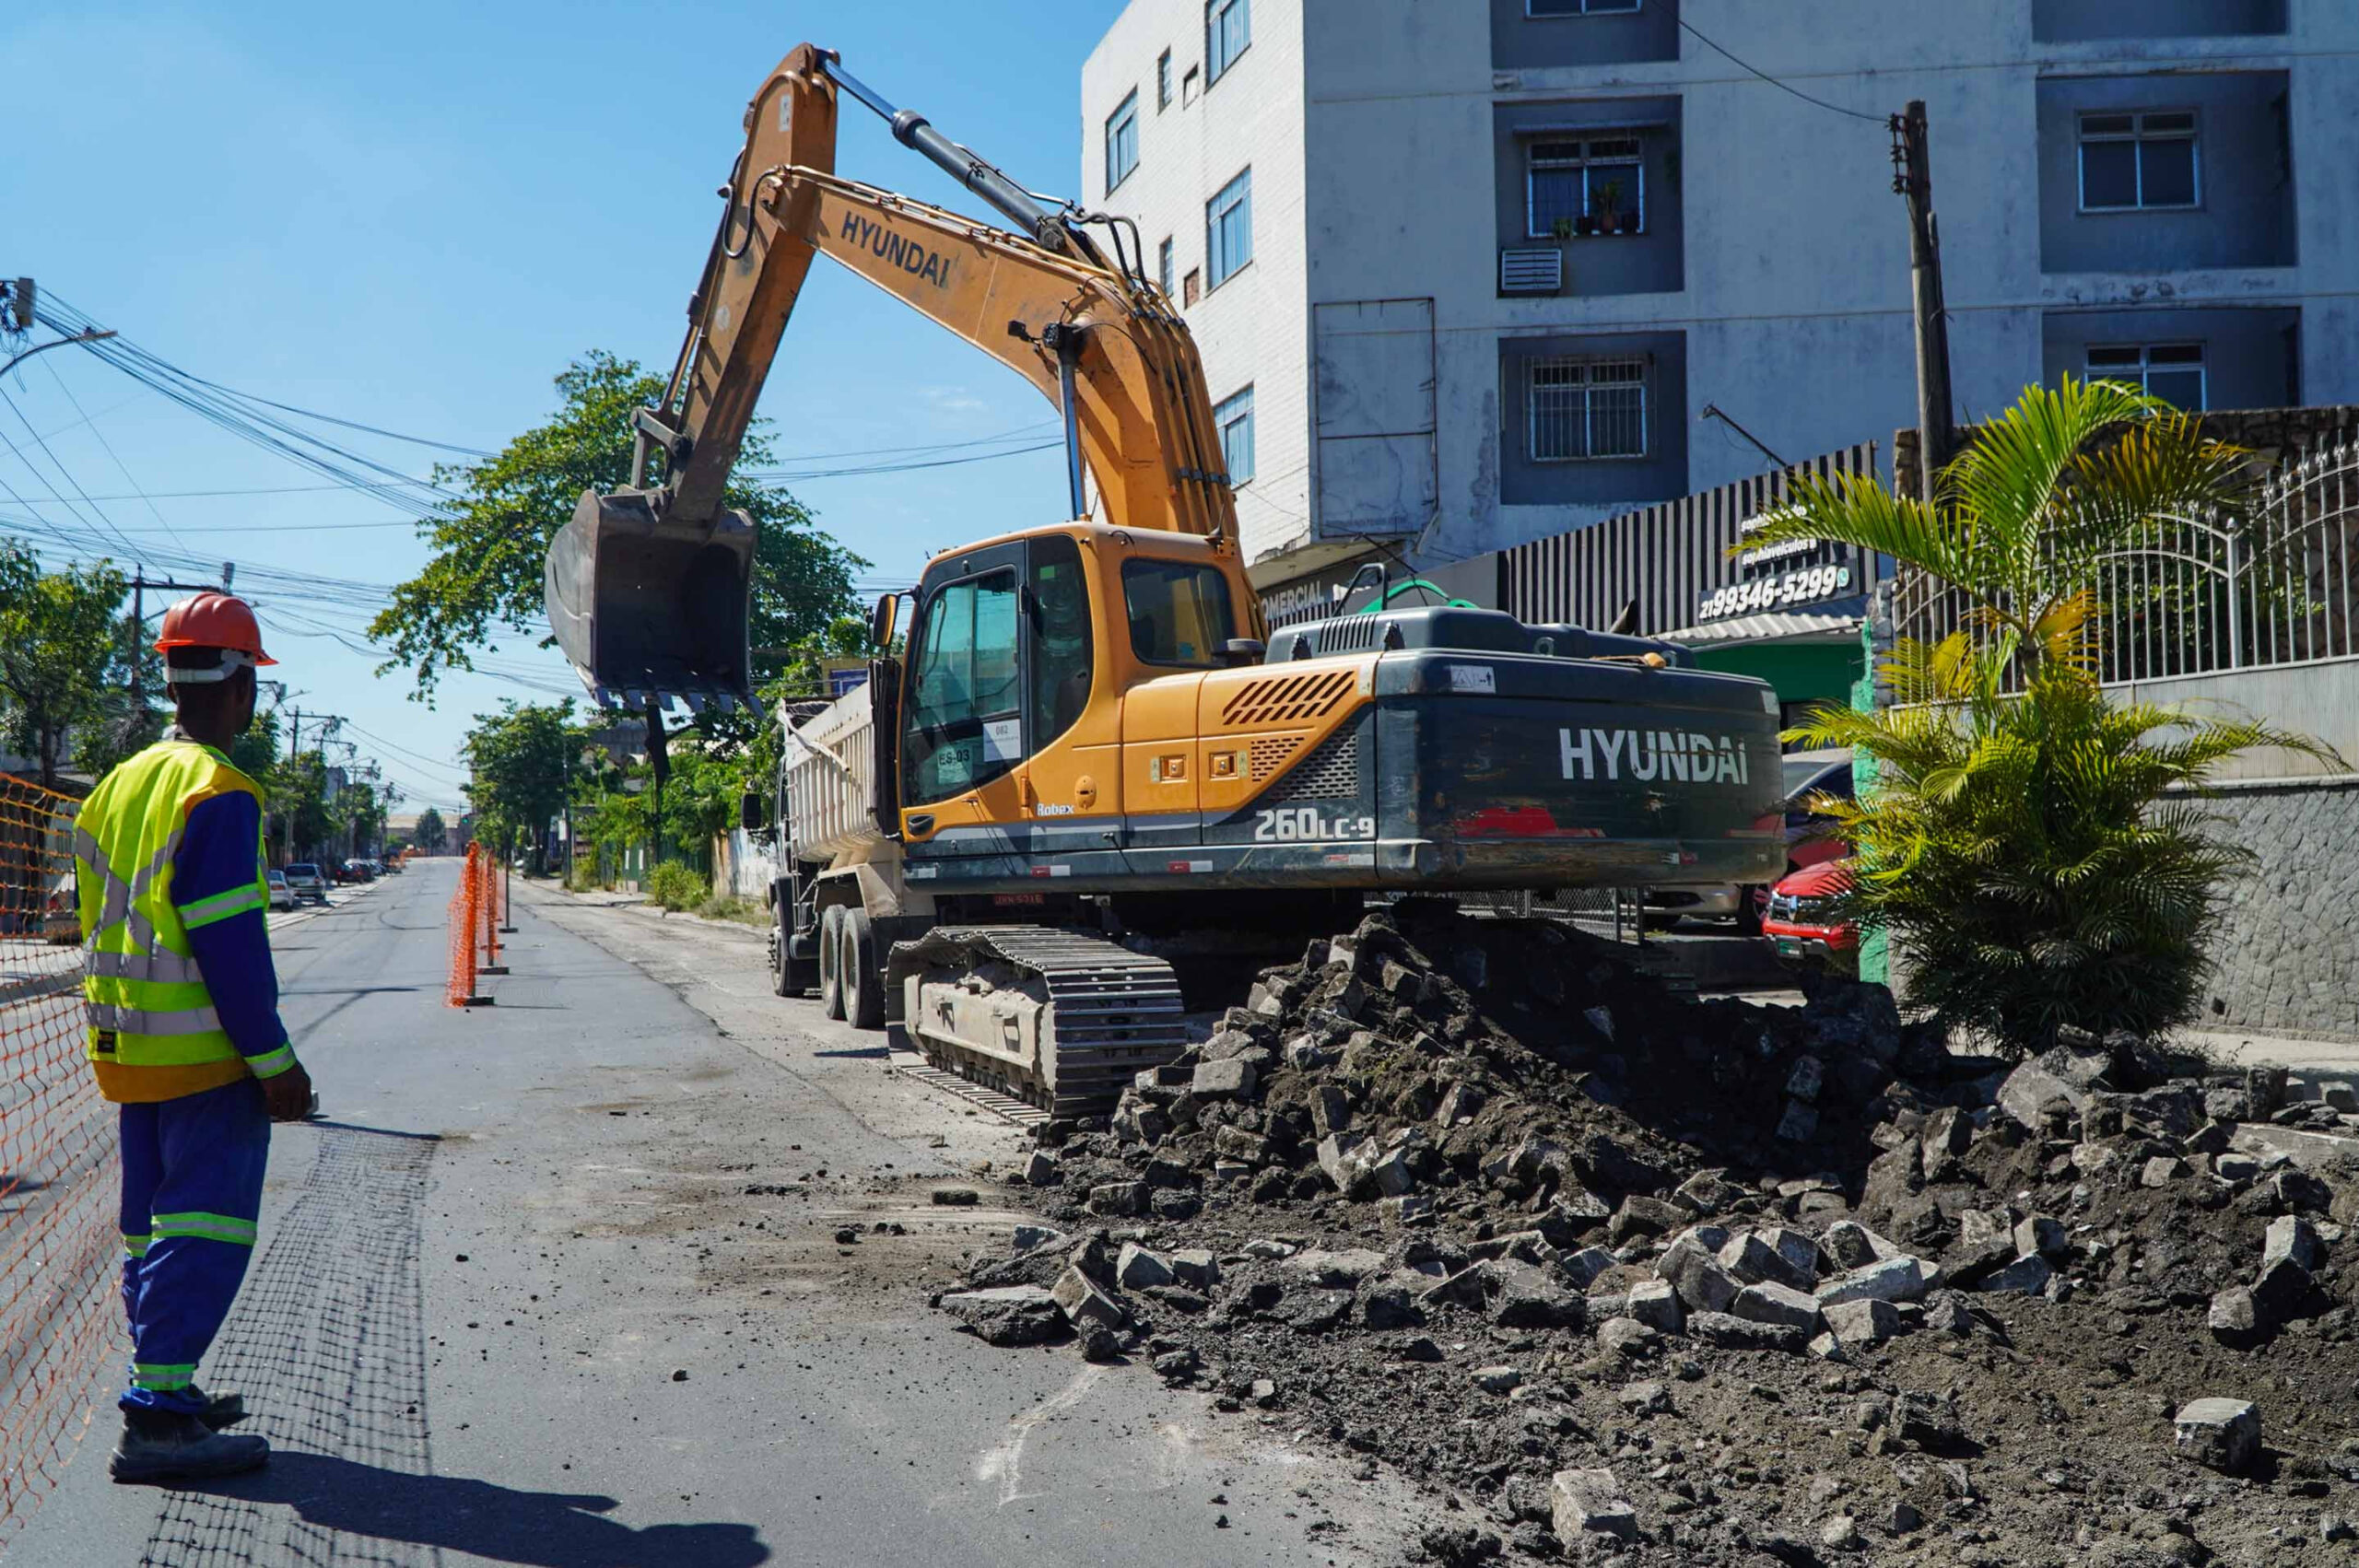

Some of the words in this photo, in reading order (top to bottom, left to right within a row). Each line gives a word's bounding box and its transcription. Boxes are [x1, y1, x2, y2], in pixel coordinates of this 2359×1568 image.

[840, 211, 950, 289] HYUNDAI
[938, 748, 970, 766] ES-03
[1559, 728, 1749, 785] HYUNDAI
[1037, 802, 1075, 817] Robex
